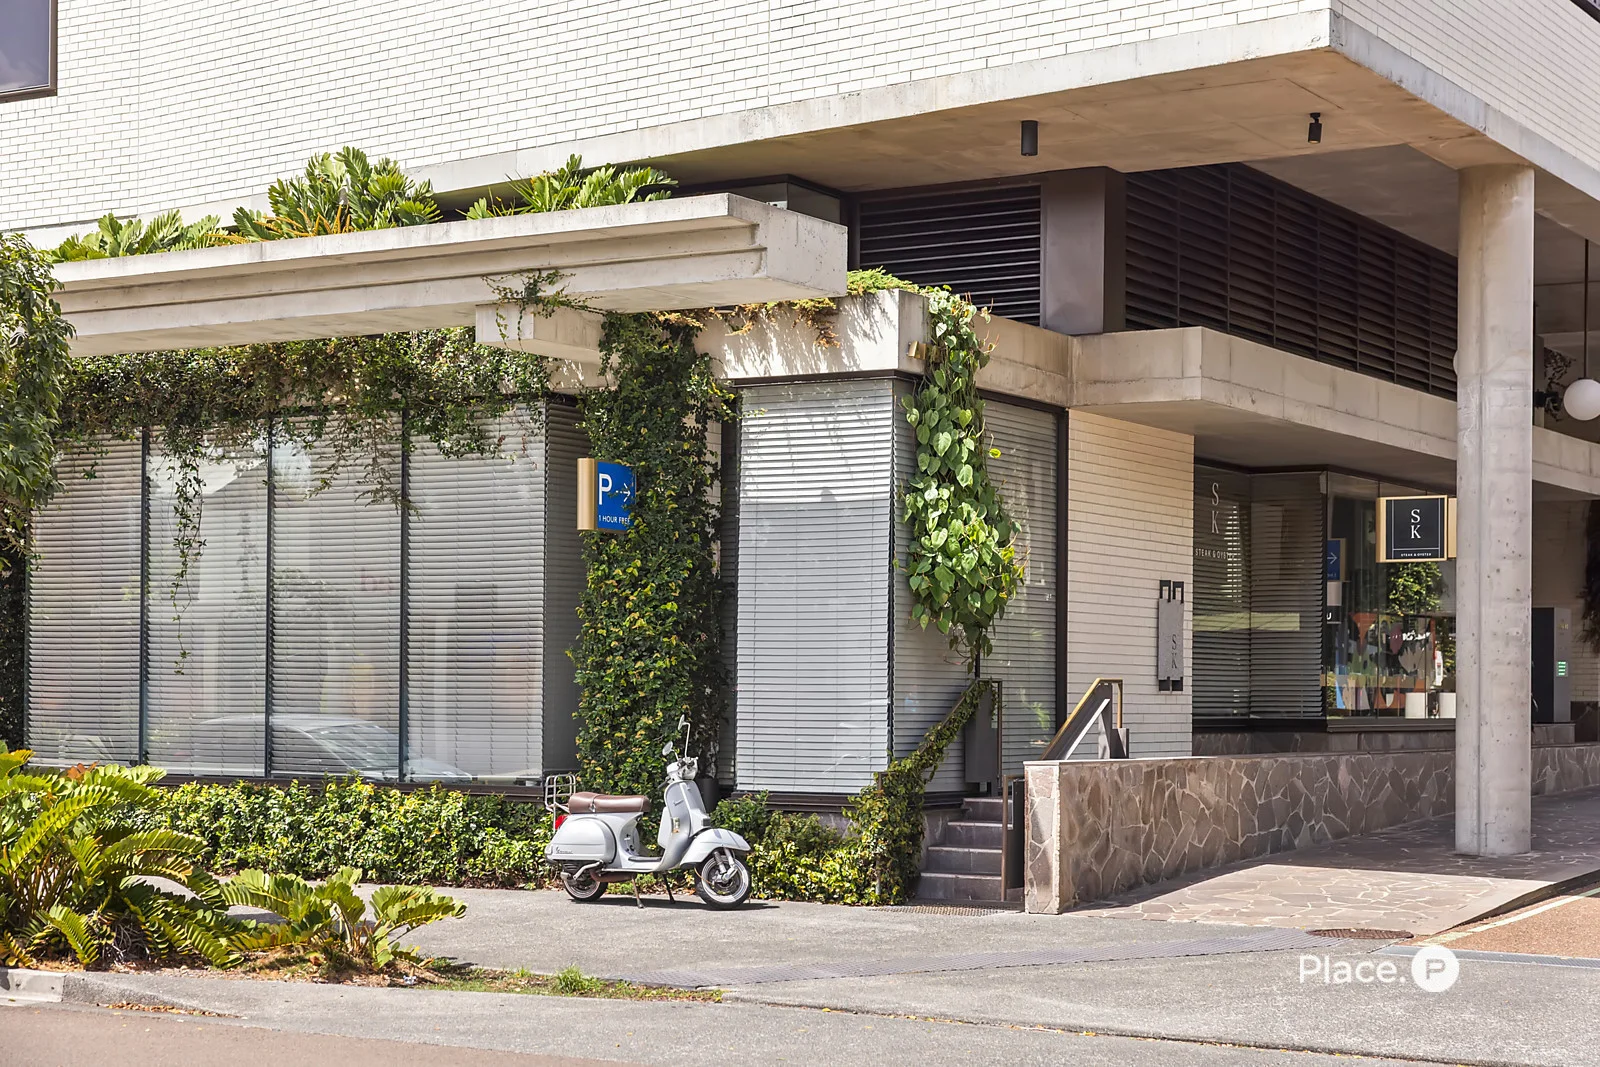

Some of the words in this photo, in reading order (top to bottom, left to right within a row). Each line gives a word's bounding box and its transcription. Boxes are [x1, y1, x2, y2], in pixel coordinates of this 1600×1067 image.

[599, 473, 612, 505] P
[603, 515, 618, 523] HOUR
[1195, 548, 1212, 558] STEAK
